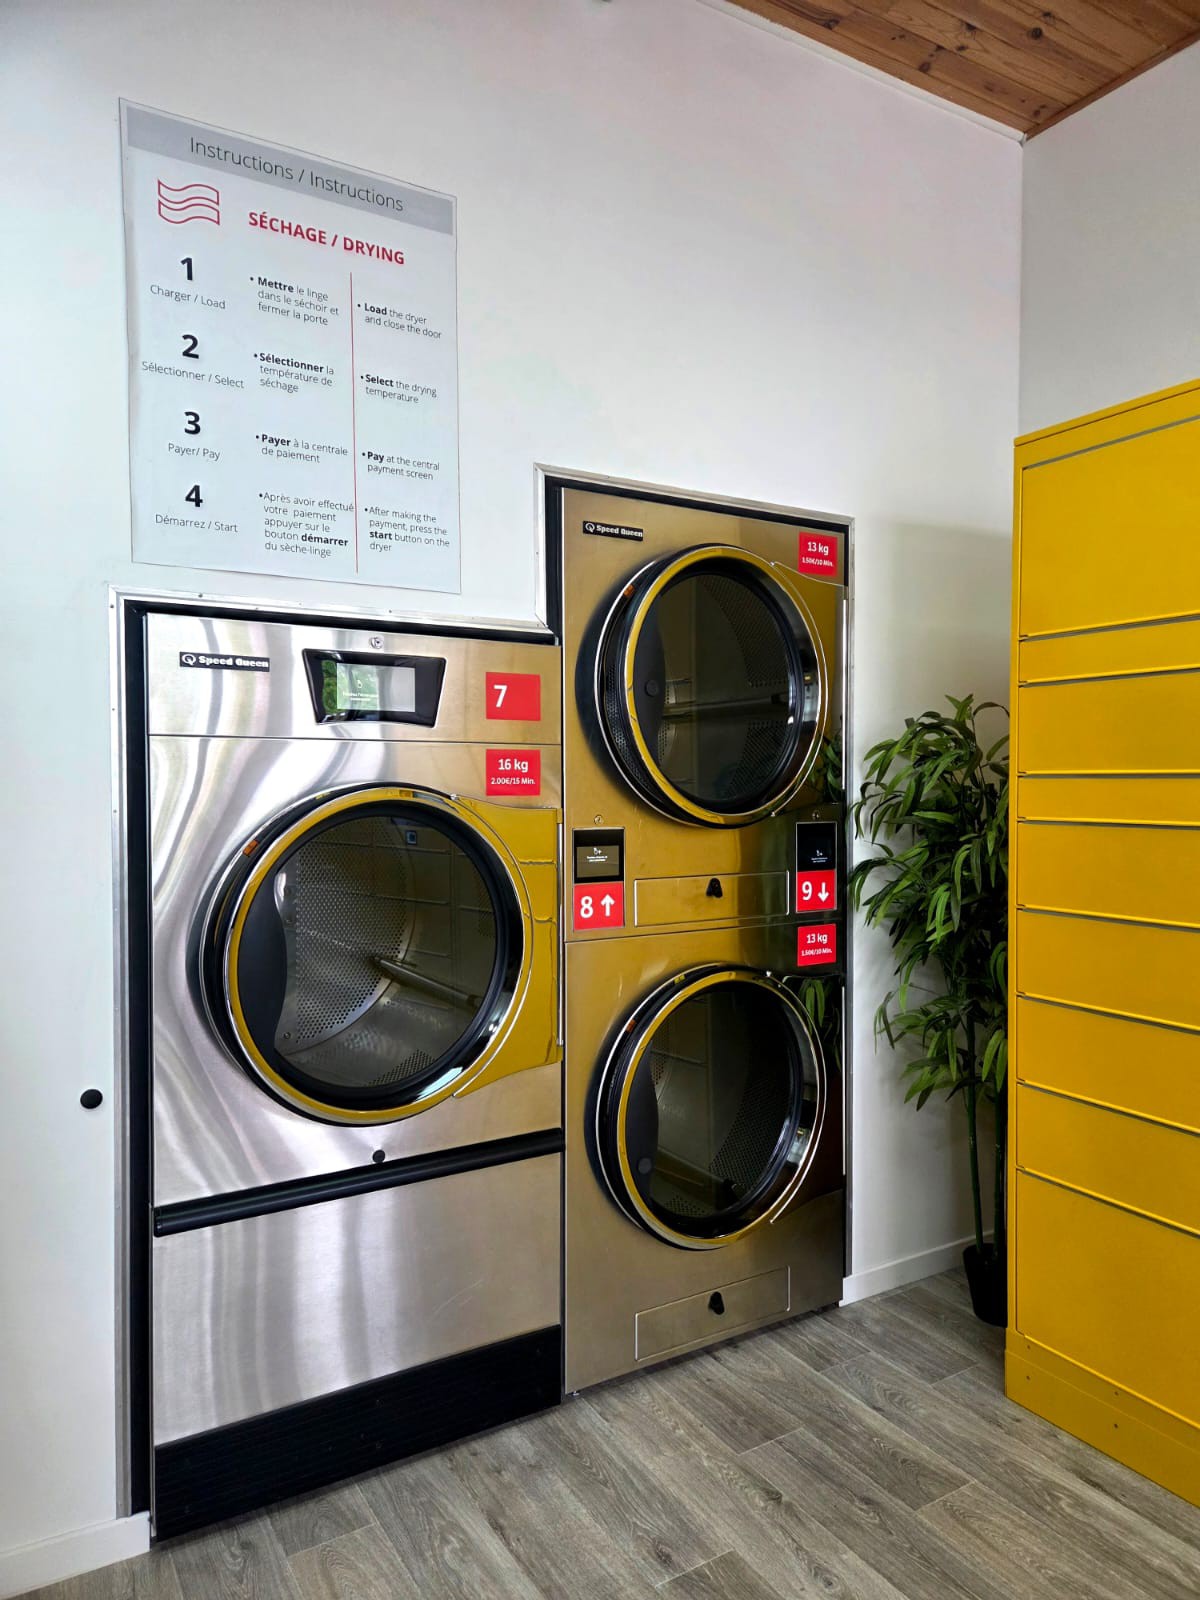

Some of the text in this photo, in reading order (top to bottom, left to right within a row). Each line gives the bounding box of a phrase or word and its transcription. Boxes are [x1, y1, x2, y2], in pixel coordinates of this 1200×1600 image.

[190, 137, 294, 180] Instructions
[310, 171, 404, 211] Instructions
[248, 211, 327, 245] SÉCHAGE
[343, 237, 405, 265] DRYING
[180, 257, 193, 281] 1
[150, 284, 191, 302] Charger
[201, 296, 226, 309] Load
[258, 276, 328, 302] Mettre le linge
[258, 290, 339, 316] dans le séchoir et
[258, 302, 328, 325] fermer la porte
[364, 302, 427, 325] Load the dryer
[365, 316, 442, 339] and close the door
[182, 334, 199, 359] 2
[259, 352, 334, 375] Sélectionner la
[141, 361, 205, 381] Sélectionner
[214, 374, 245, 389] Select
[260, 365, 333, 387] température de
[260, 377, 299, 393] séchage
[365, 373, 437, 398] Select the drying
[366, 386, 419, 403] temperature
[184, 411, 201, 435] 3
[202, 448, 220, 461] Pay
[261, 434, 348, 456] Payer à la centrale
[261, 446, 320, 463] de paiement
[367, 451, 440, 471] Pay at the central
[367, 464, 434, 480] payment screen
[185, 484, 203, 507] 4
[263, 492, 354, 512] Après avoir effectué
[263, 505, 337, 521] votre paiement
[369, 506, 437, 523] After making the
[155, 514, 206, 529] Démarrez
[214, 521, 239, 533] Start
[264, 518, 330, 533] appuyer sur le
[369, 519, 448, 536] payment, press the
[596, 525, 619, 534] Speed
[620, 528, 643, 537] Queen
[264, 528, 349, 547] bouton démarrer
[369, 531, 450, 547] start button on the
[369, 541, 392, 552] dryer
[264, 541, 332, 558] du sèche-linge
[807, 541, 829, 556] 13 kg
[198, 655, 233, 666] Speed
[235, 658, 269, 668] Queen
[493, 684, 508, 708] 7
[497, 758, 529, 773] 16 kg
[490, 777, 536, 785] 2.00€/15 Min.
[801, 881, 813, 901] 9
[579, 895, 594, 919] 8
[806, 932, 828, 945] 13 kg
